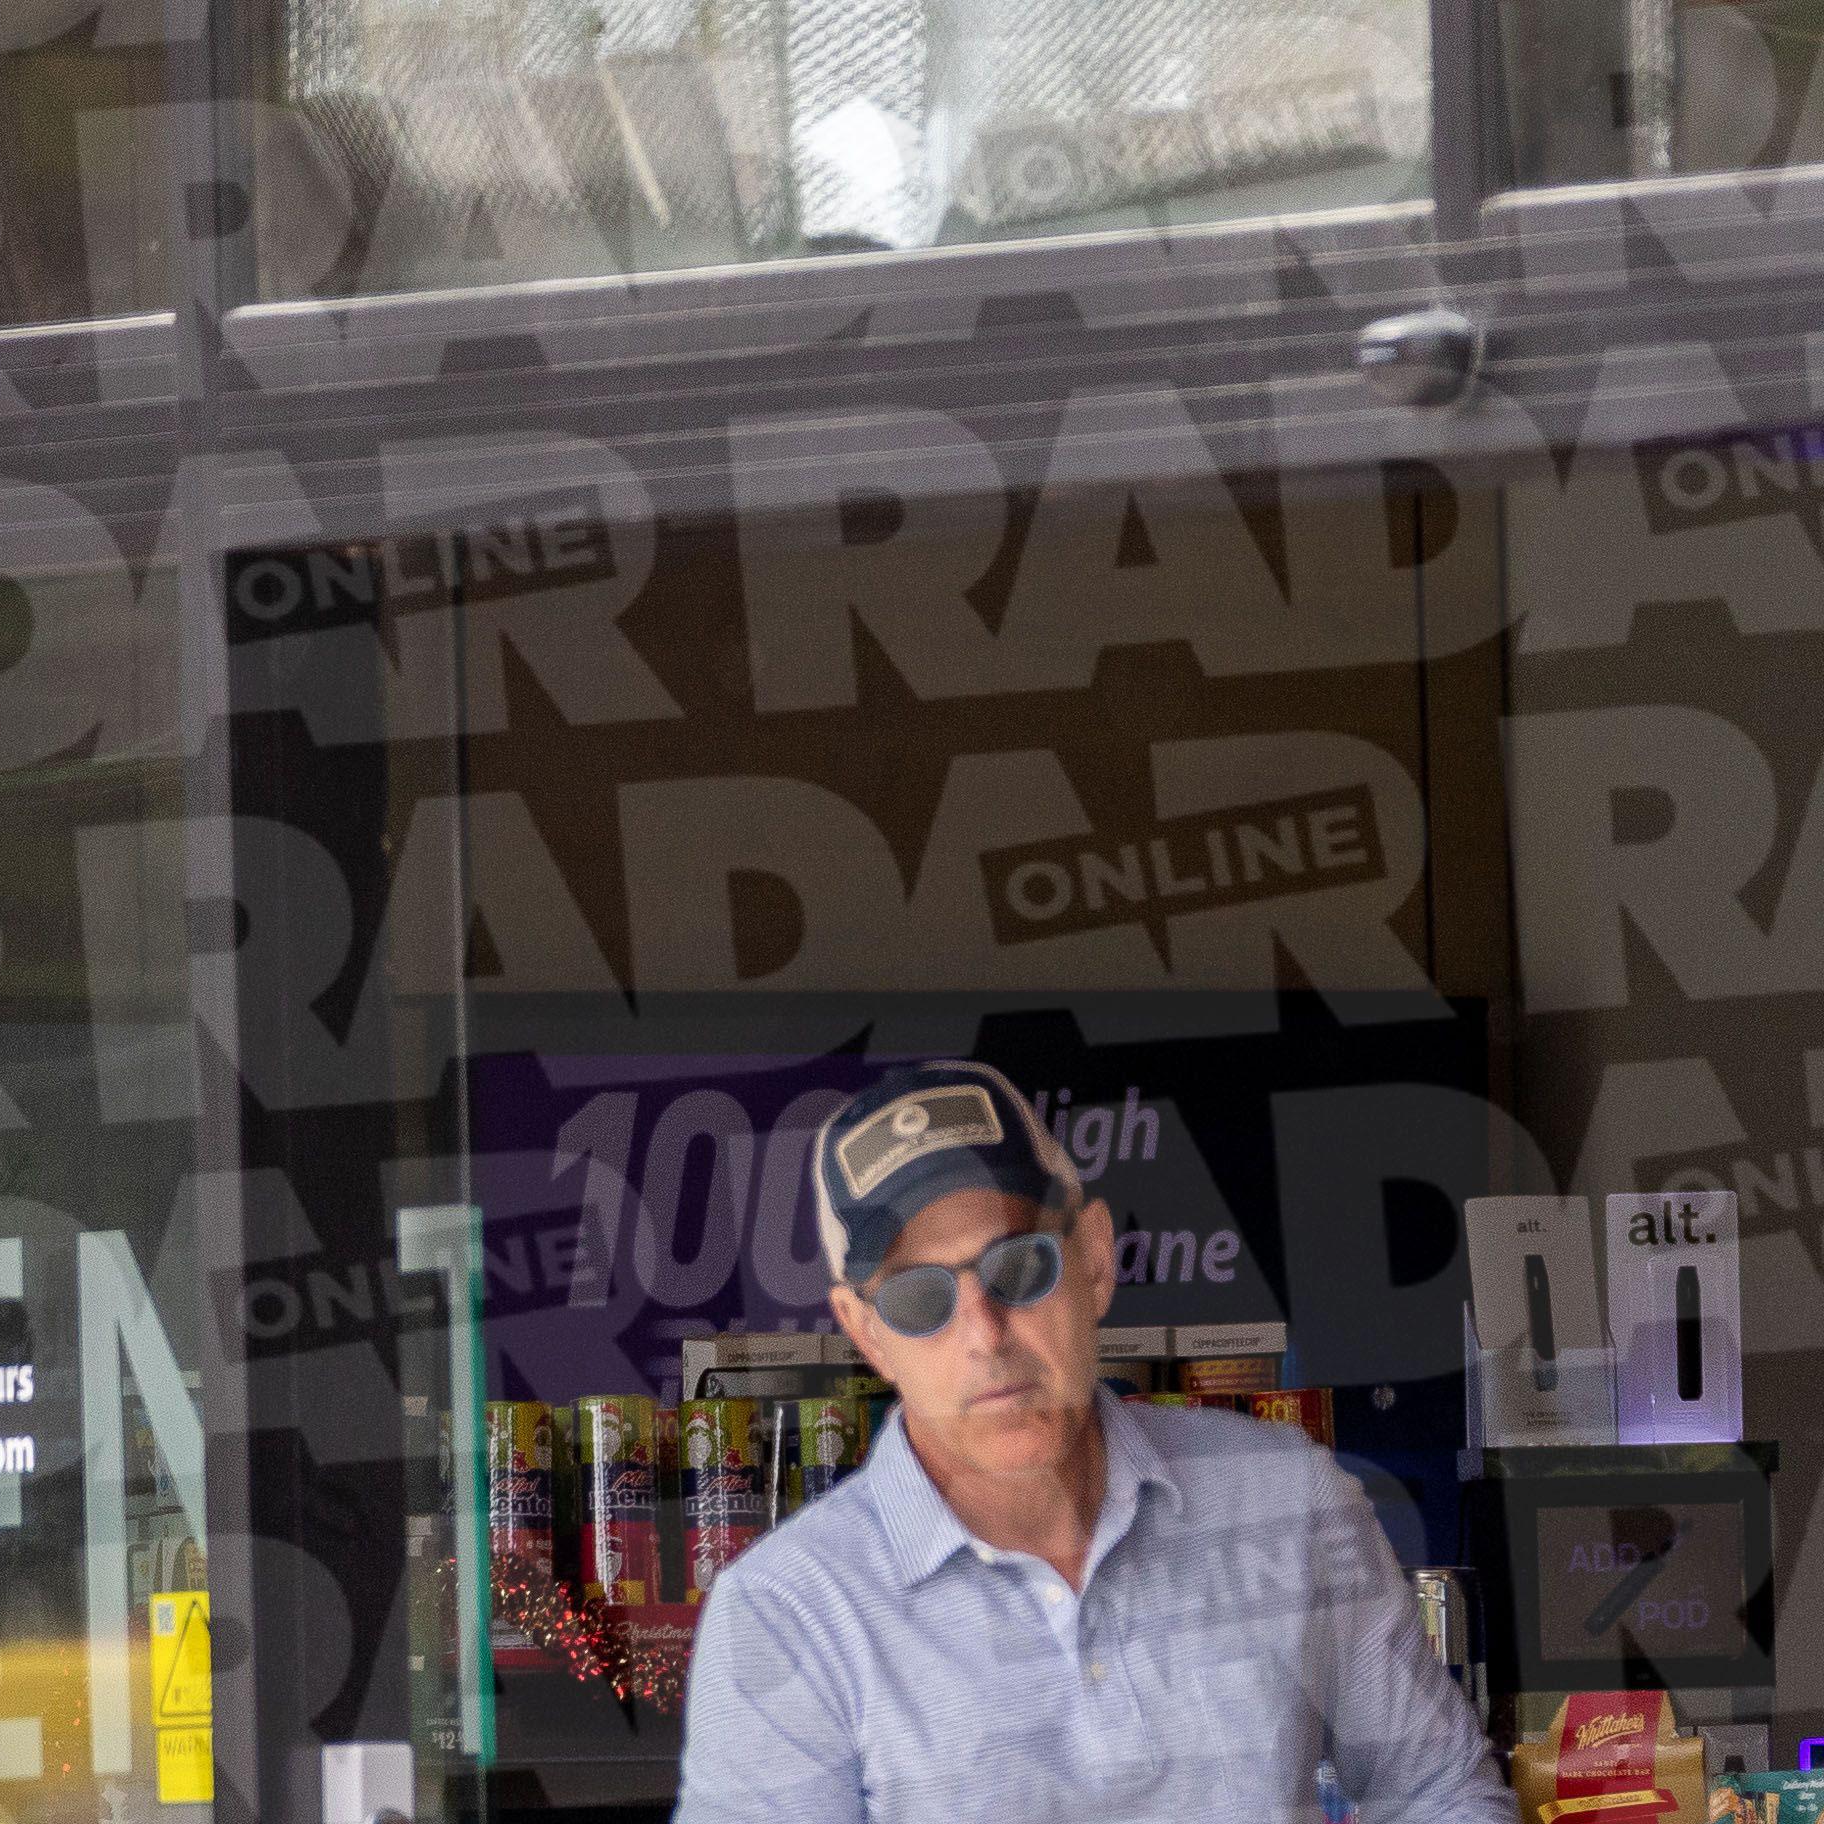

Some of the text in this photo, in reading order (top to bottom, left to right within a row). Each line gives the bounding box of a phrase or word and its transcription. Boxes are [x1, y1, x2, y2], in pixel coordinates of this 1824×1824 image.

[1516, 1218, 1548, 1234] alt.
[1628, 1201, 1718, 1246] alt.
[1114, 1227, 1240, 1283] ane
